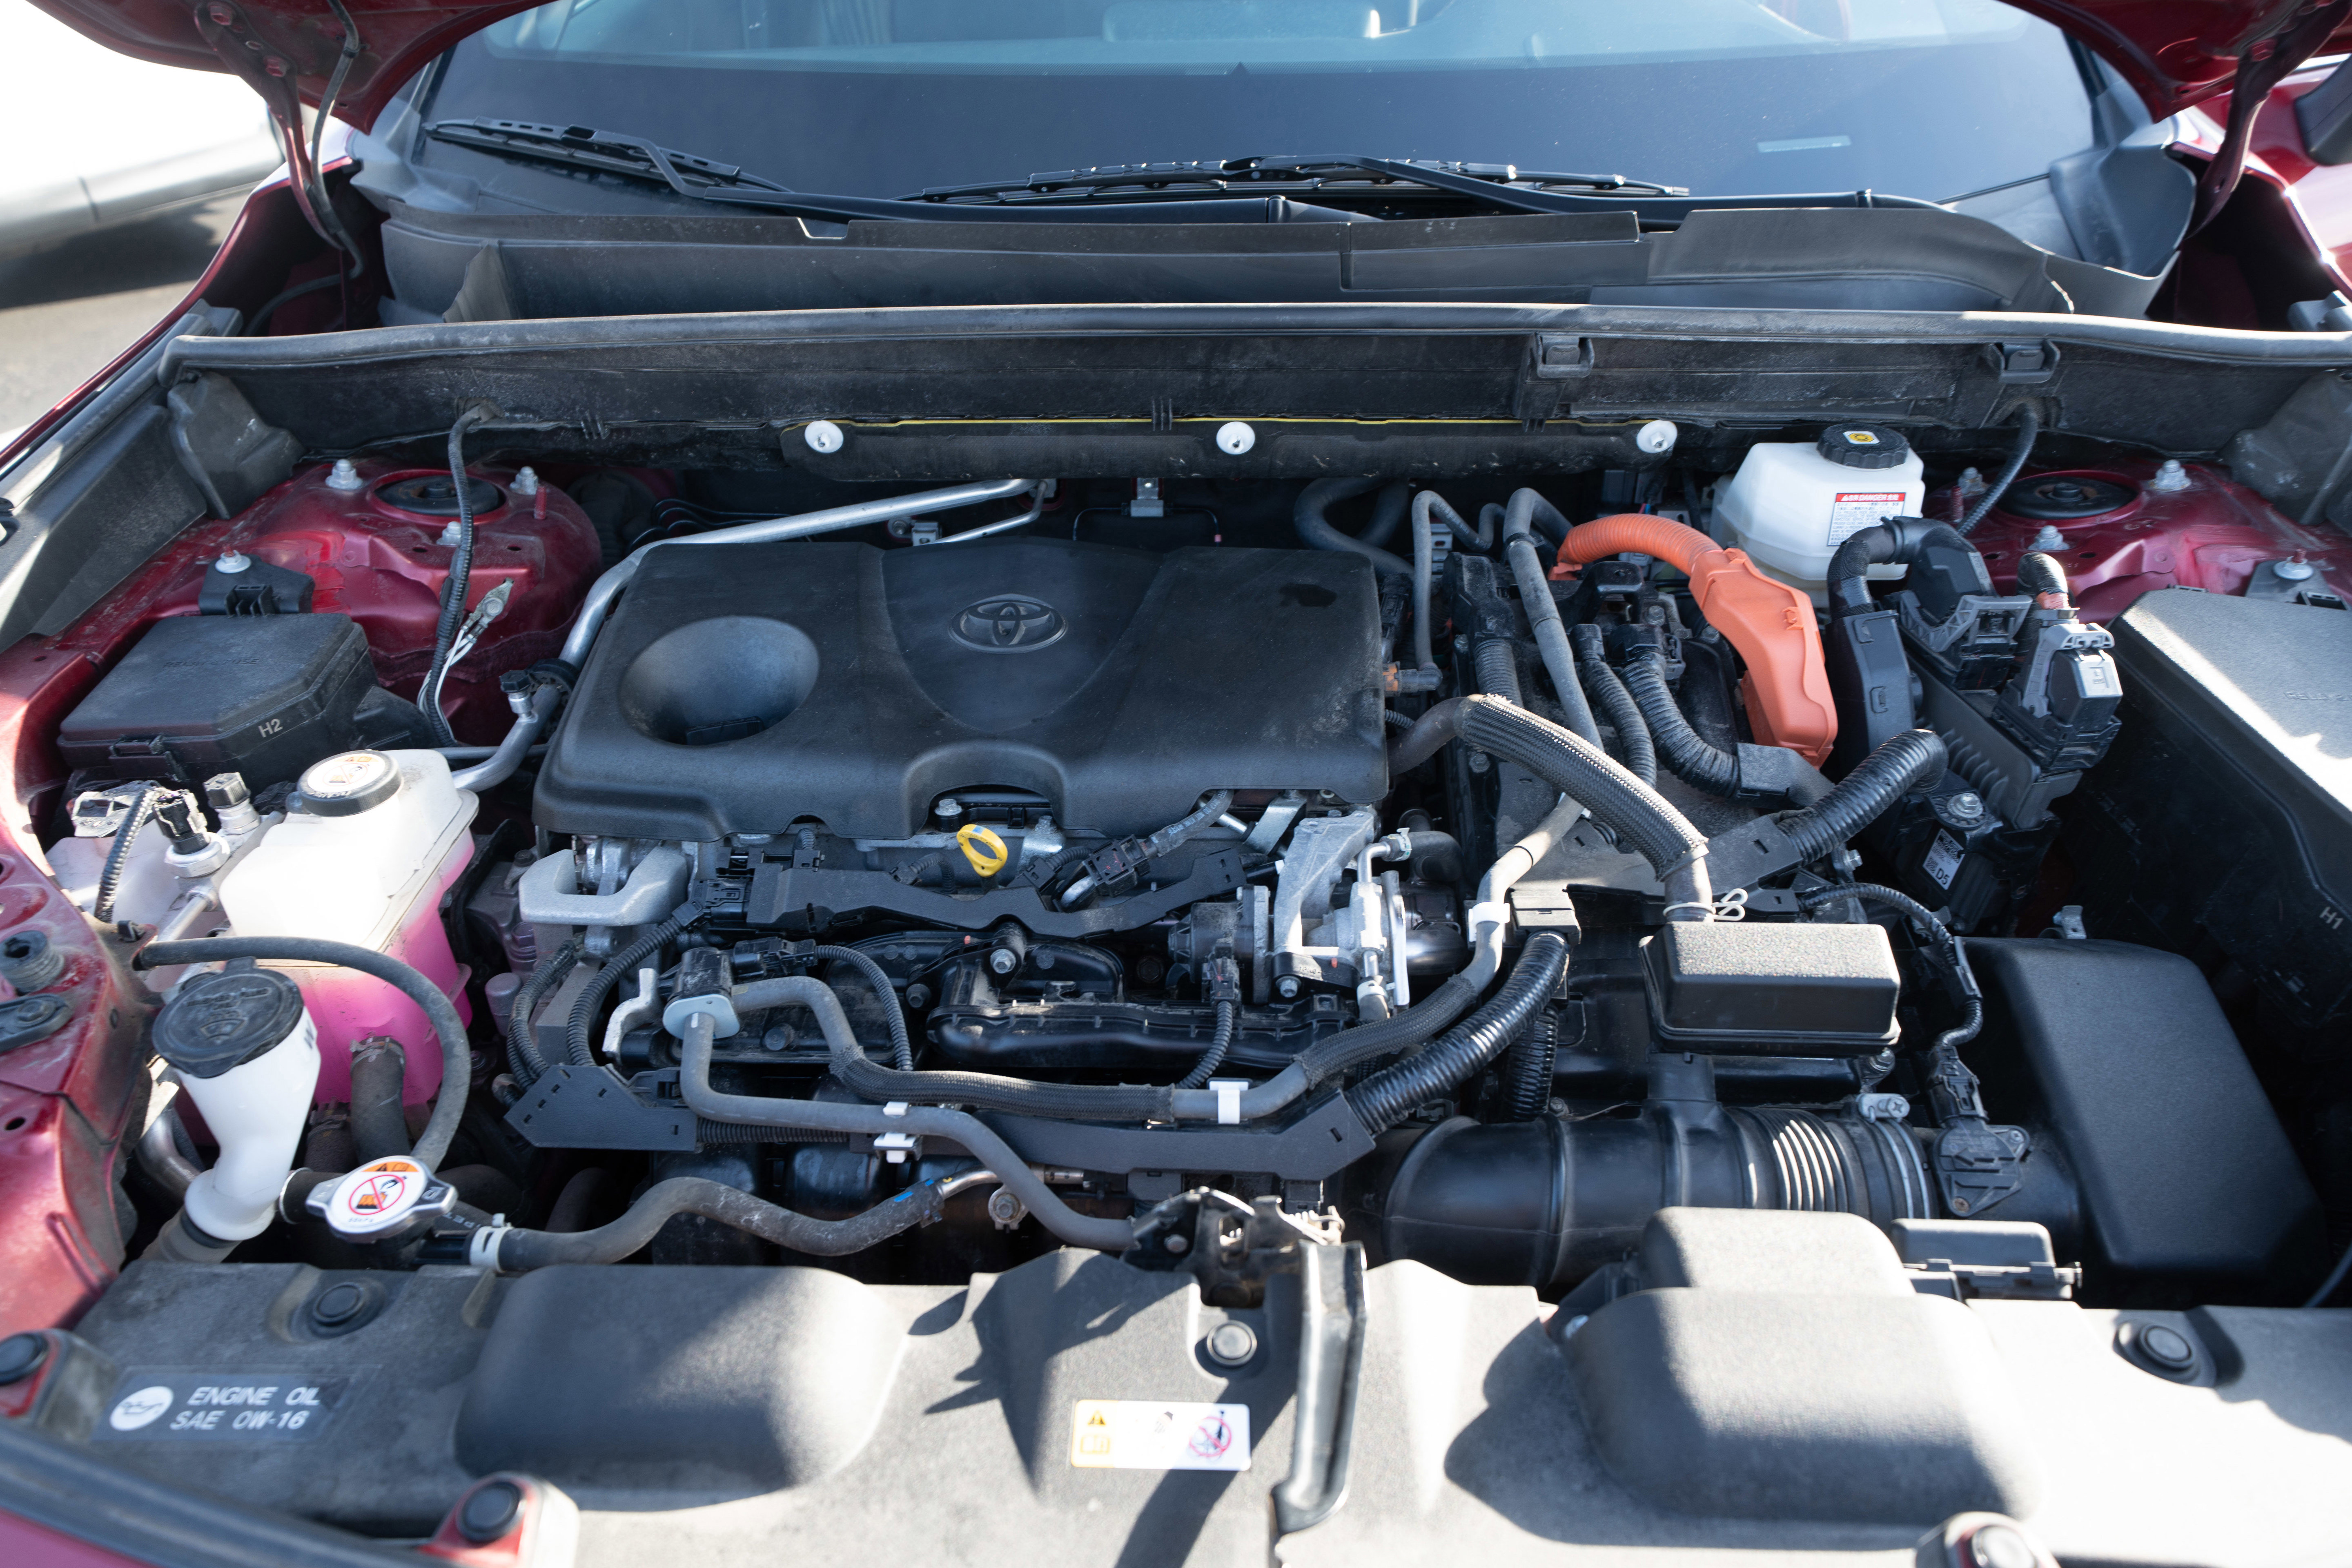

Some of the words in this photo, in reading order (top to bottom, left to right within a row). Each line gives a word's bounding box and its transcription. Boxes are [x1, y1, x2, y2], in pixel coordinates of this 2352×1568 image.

[258, 718, 283, 738] H2
[1936, 867, 1950, 885] D5
[2319, 906, 2343, 929] H1
[187, 1386, 279, 1406] ENGINE
[285, 1387, 320, 1405] OIL
[170, 1410, 226, 1430] SAE
